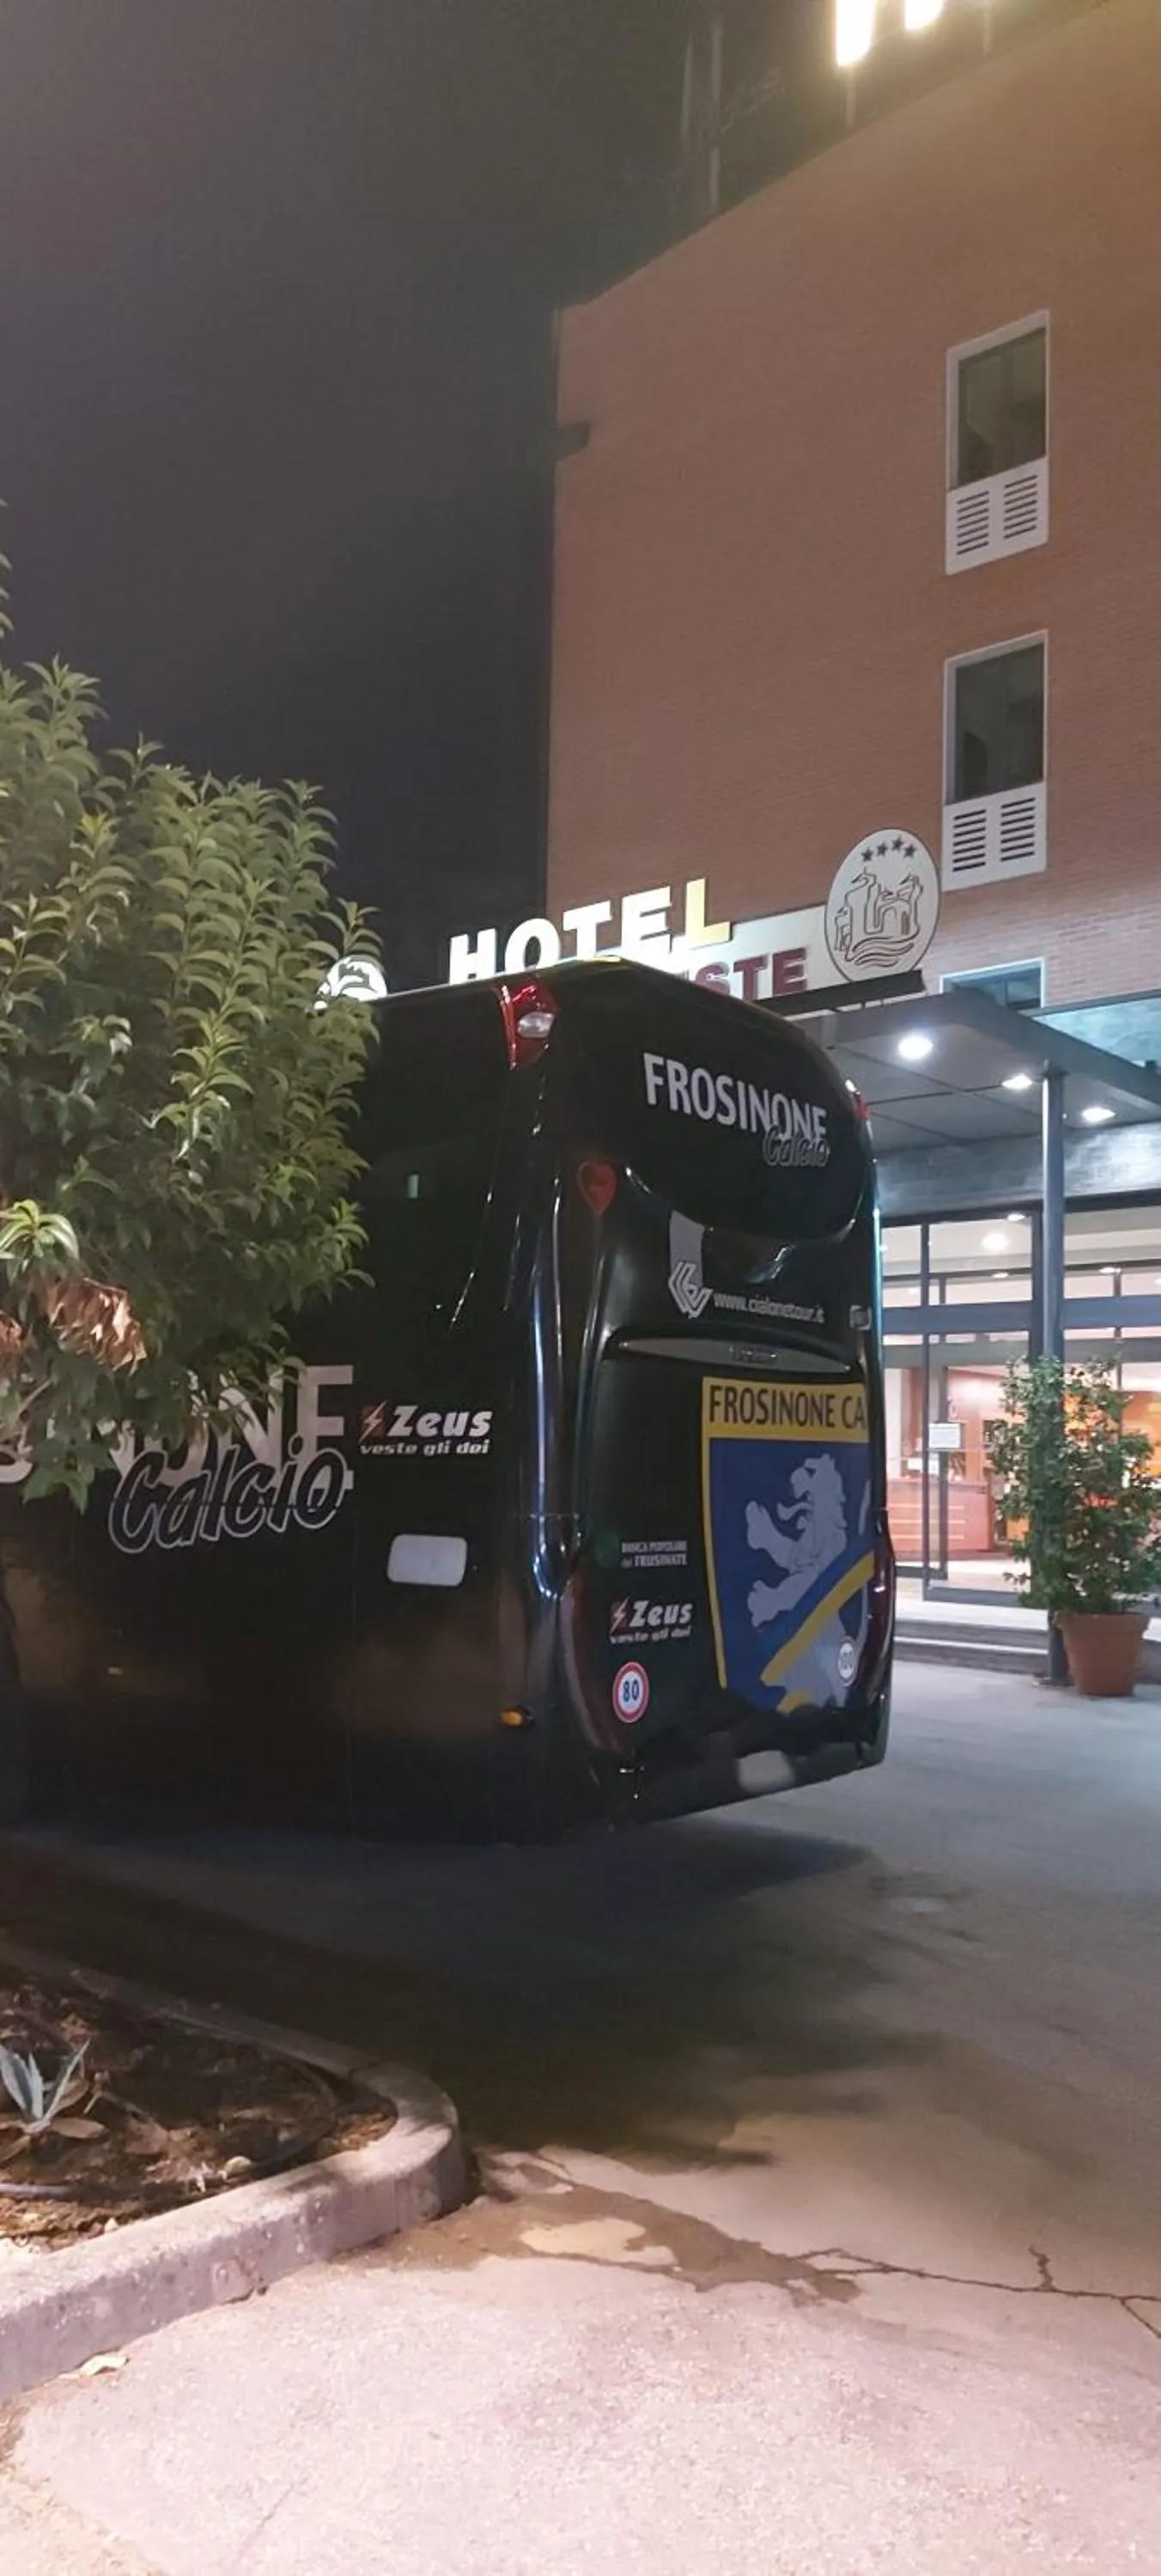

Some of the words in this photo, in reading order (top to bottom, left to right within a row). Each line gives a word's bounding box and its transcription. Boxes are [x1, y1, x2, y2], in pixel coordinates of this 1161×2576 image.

[449, 878, 730, 985] HOTEL
[692, 947, 808, 1001] STE
[643, 1052, 828, 1143] FROSINONE
[387, 1405, 494, 1438] Zeus
[709, 1385, 836, 1428] FROSINONE
[359, 1443, 418, 1455] veste
[423, 1440, 451, 1457] gli
[456, 1438, 490, 1455] dei
[108, 1432, 348, 1554] Calcio
[629, 1600, 693, 1627] Zeus
[623, 1679, 640, 1703] 80
